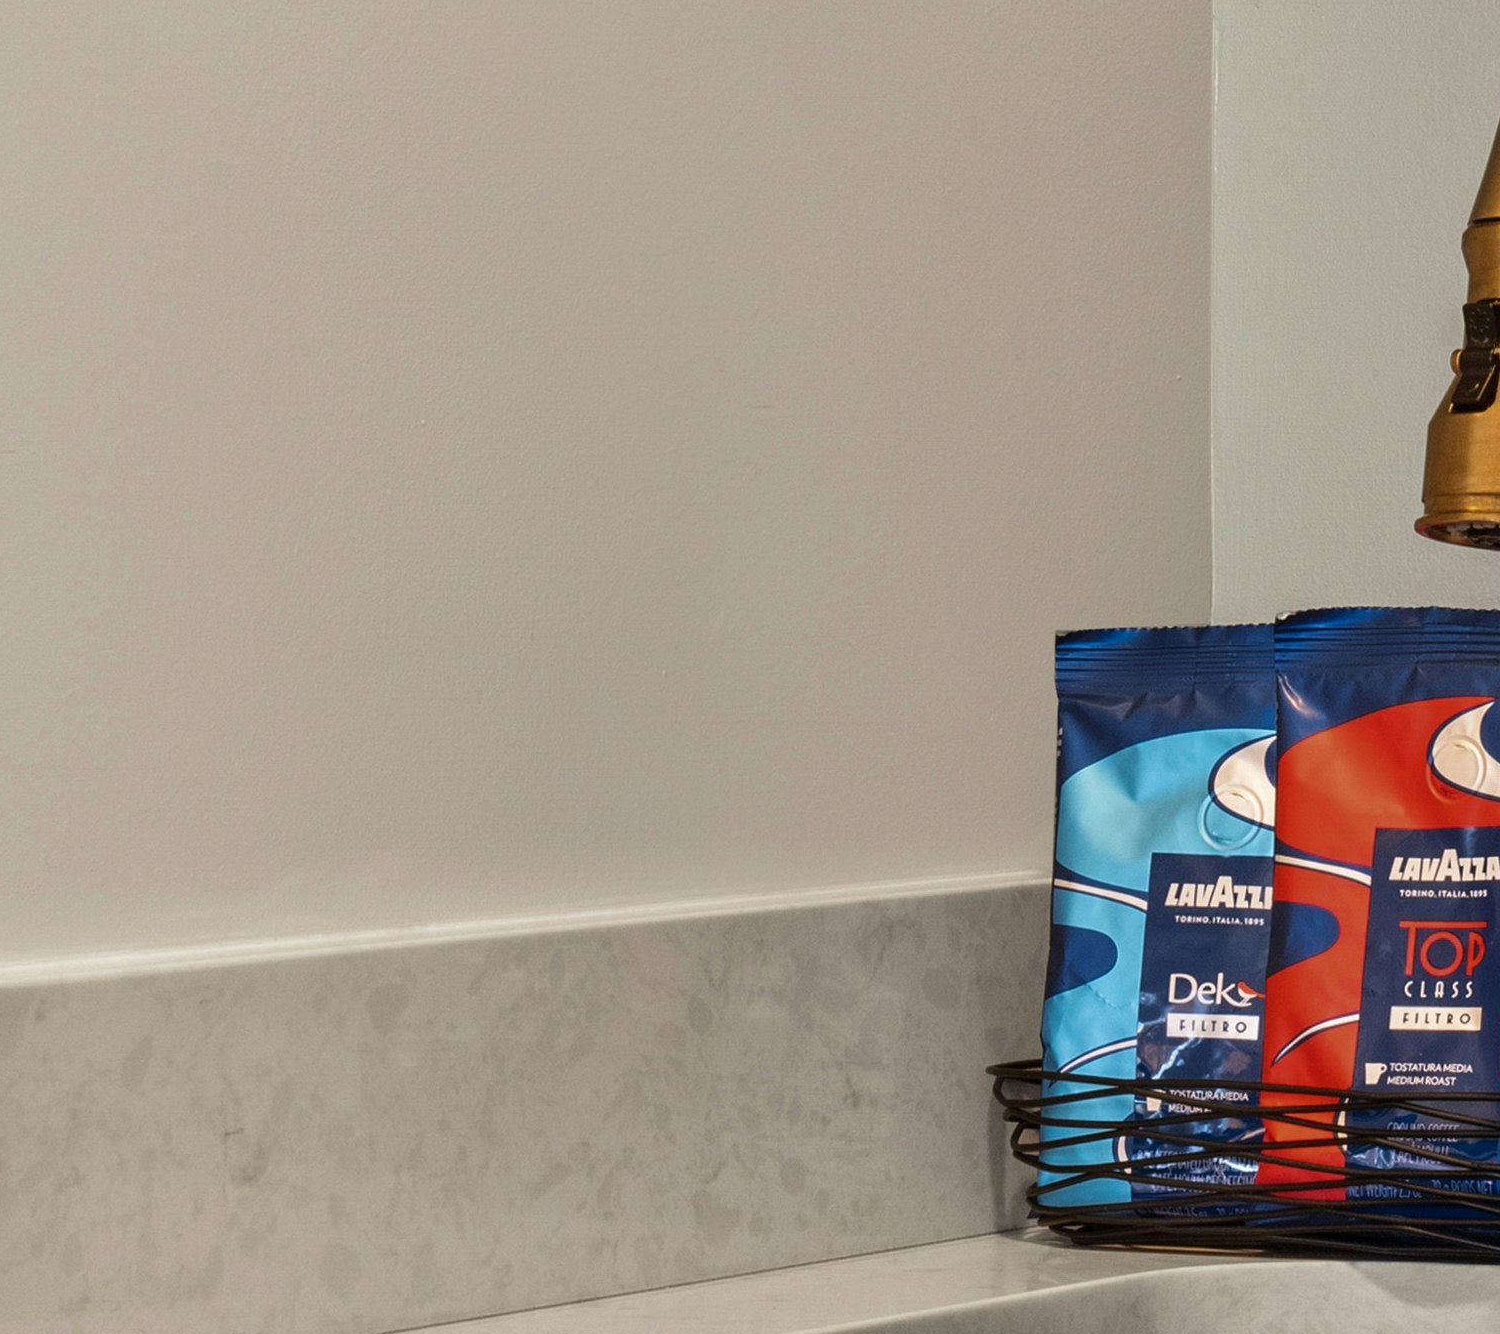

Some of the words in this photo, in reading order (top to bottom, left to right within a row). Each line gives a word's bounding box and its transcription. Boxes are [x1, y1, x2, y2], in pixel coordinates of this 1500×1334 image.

[1470, 889, 1488, 898] 1895
[1244, 917, 1264, 926] 1895
[1399, 920, 1487, 977] TOP
[1168, 972, 1252, 1007] Dek
[1404, 980, 1473, 998] CLASS
[1402, 1012, 1471, 1024] FILTRO
[1179, 1019, 1247, 1033] FILTRO
[1389, 1062, 1441, 1072] TOSTATURA
[1443, 1063, 1473, 1073] MEDIA
[1387, 1076, 1424, 1085] MEDIUM
[1425, 1076, 1456, 1086] ROAST
[1220, 1091, 1249, 1102] MEDIA
[1168, 1104, 1203, 1114] MEDIUM
